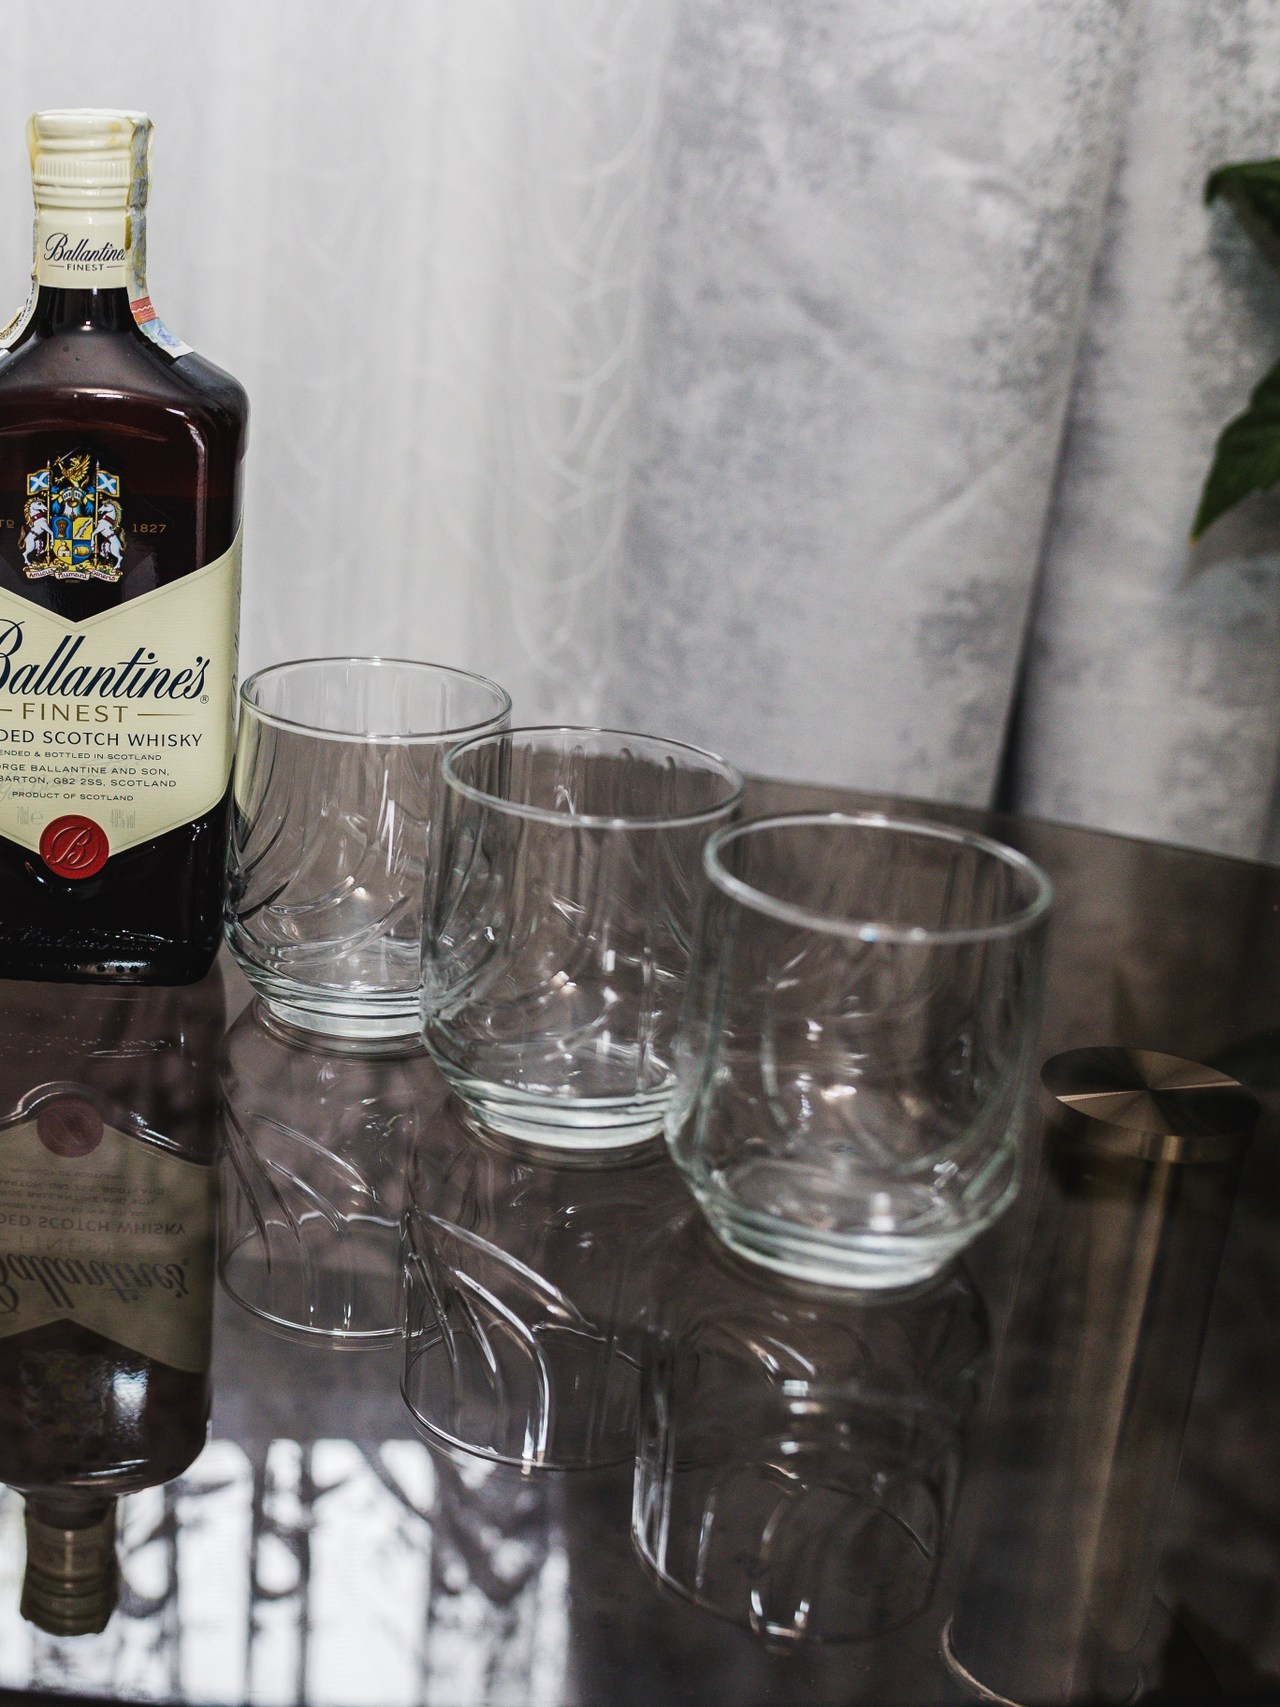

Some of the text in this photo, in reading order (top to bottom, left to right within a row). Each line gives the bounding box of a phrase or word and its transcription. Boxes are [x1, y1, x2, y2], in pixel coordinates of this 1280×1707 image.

[44, 233, 125, 261] Ballantine
[132, 524, 166, 533] 1827
[23, 703, 128, 722] FINEST
[43, 731, 119, 746] SCOTCH
[128, 733, 203, 747] WHISKY
[31, 764, 106, 774] BALLANTINE
[111, 767, 136, 775] AND
[141, 768, 169, 776] SON,
[53, 777, 75, 785] G82
[80, 778, 106, 787] 2SS,
[111, 779, 176, 787] SCOTLAND
[12, 791, 59, 799] PRODUCT
[46, 826, 99, 871] B
